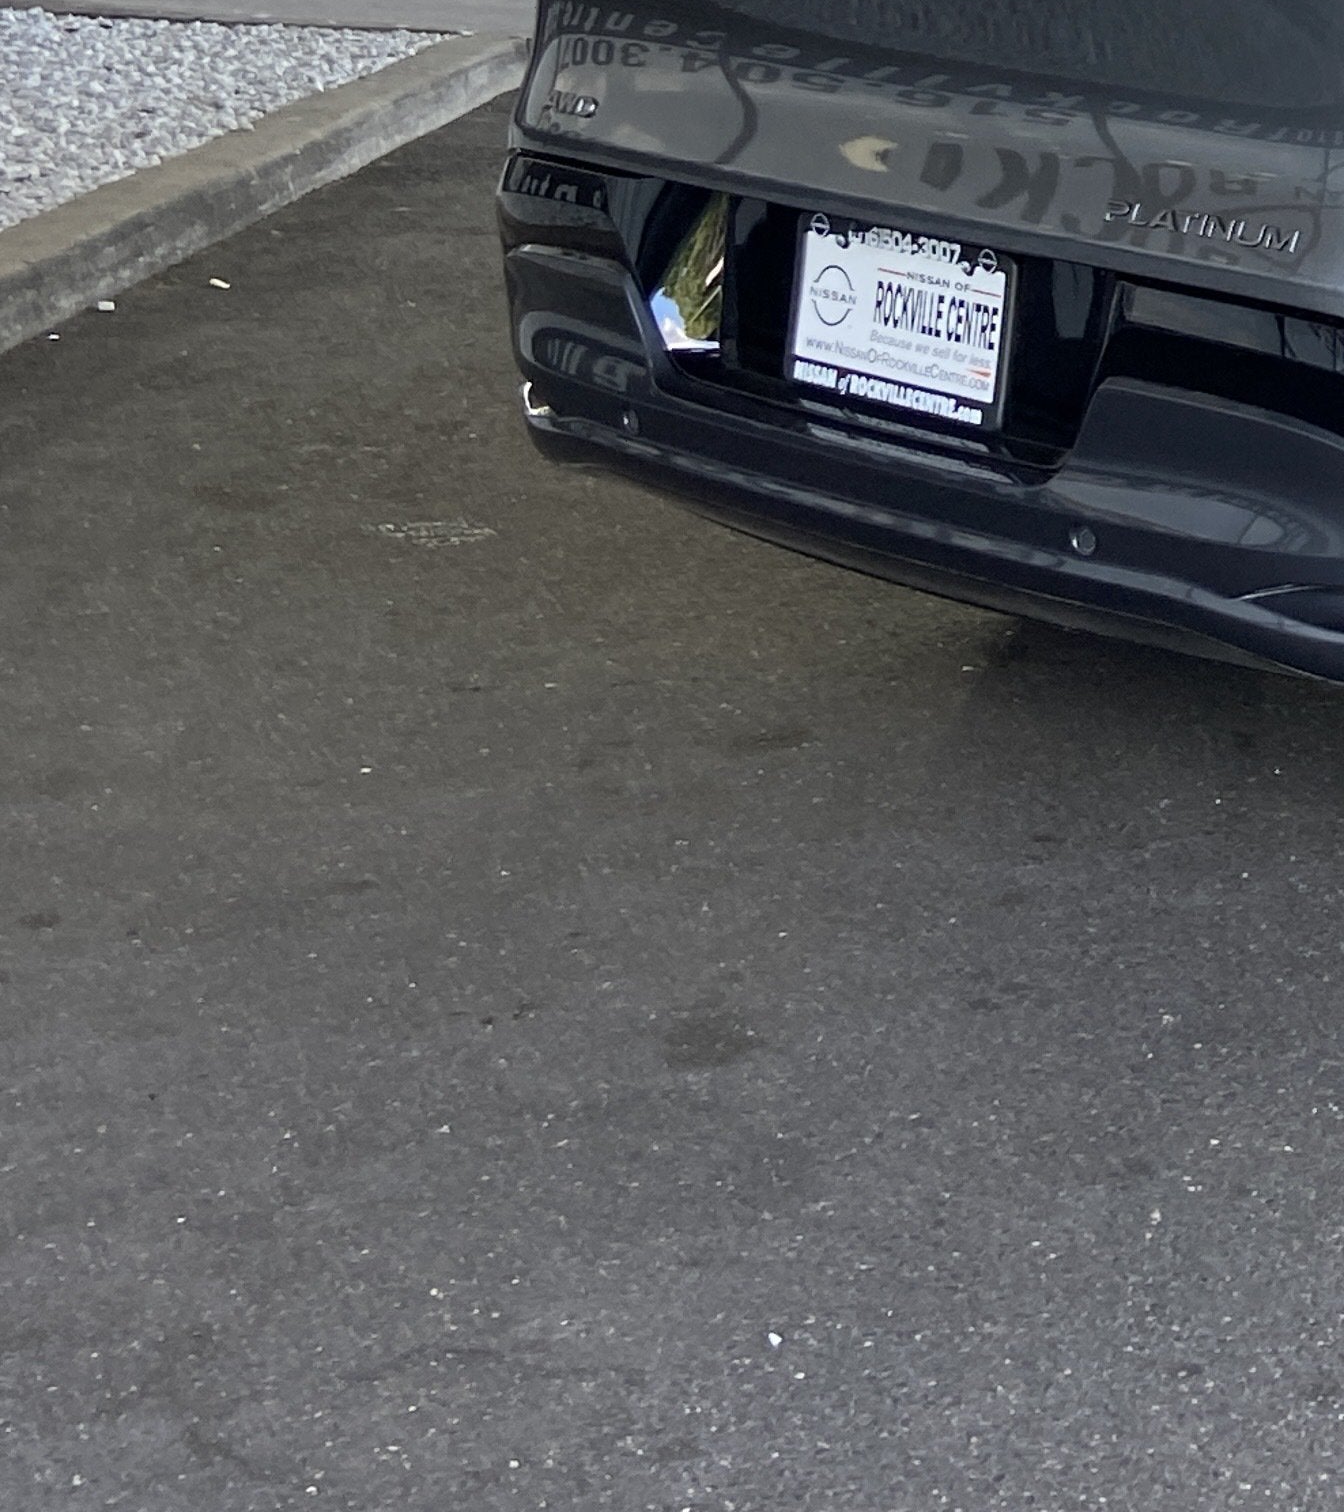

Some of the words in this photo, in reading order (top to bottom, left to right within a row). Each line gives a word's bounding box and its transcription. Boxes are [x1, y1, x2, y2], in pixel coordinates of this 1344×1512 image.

[549, 90, 599, 118] AWD
[1104, 199, 1300, 253] PLATINUM
[809, 285, 858, 305] NISSAN
[907, 271, 950, 288] NISSAN
[954, 281, 970, 293] OF
[873, 280, 945, 338] ROCKVILLE
[946, 295, 999, 350] CENTRE
[870, 329, 913, 350] Because
[914, 343, 930, 354] we
[793, 359, 838, 388] NISSAN
[838, 374, 851, 395] of
